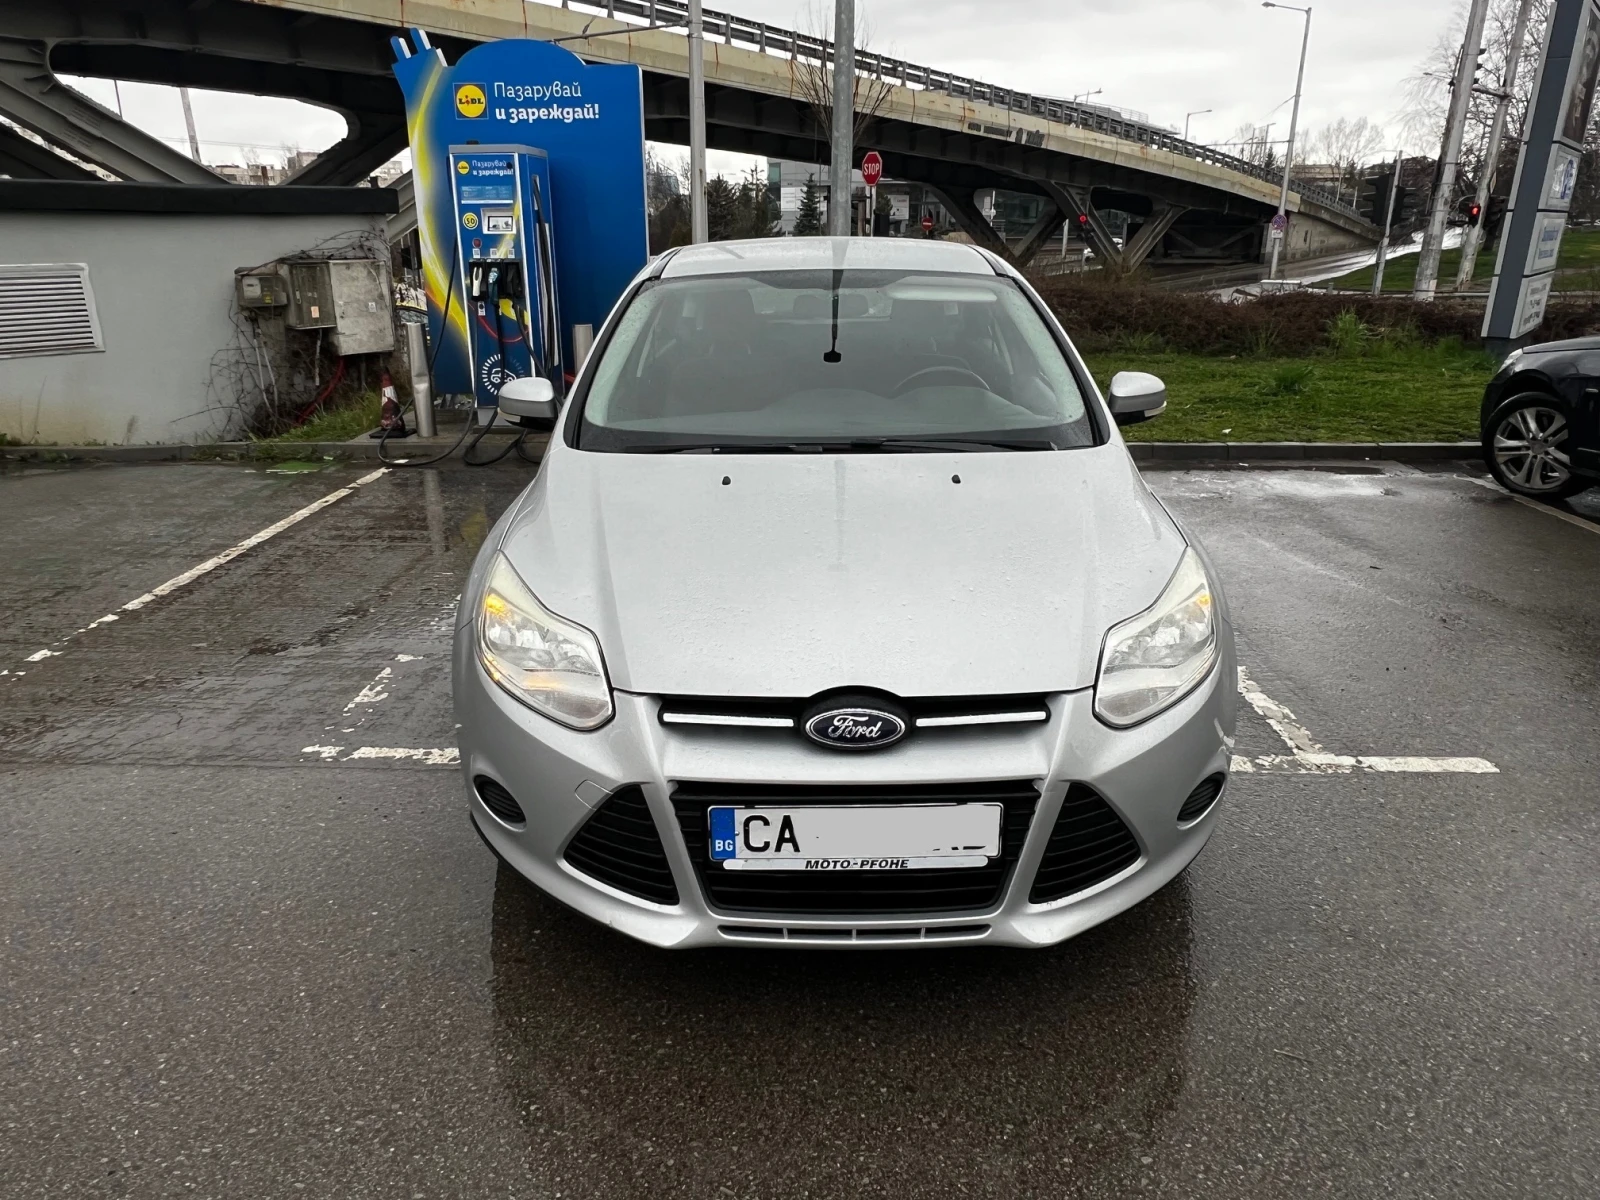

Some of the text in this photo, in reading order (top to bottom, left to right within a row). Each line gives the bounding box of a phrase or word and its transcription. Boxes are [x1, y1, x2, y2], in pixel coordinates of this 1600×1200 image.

[494, 81, 582, 101] Пазарувай
[495, 104, 600, 123] и зареждай!
[863, 163, 880, 176] STOP
[828, 715, 883, 738] Ford
[714, 814, 801, 853] BG CA
[805, 859, 910, 870] MOTO-PFOHE
